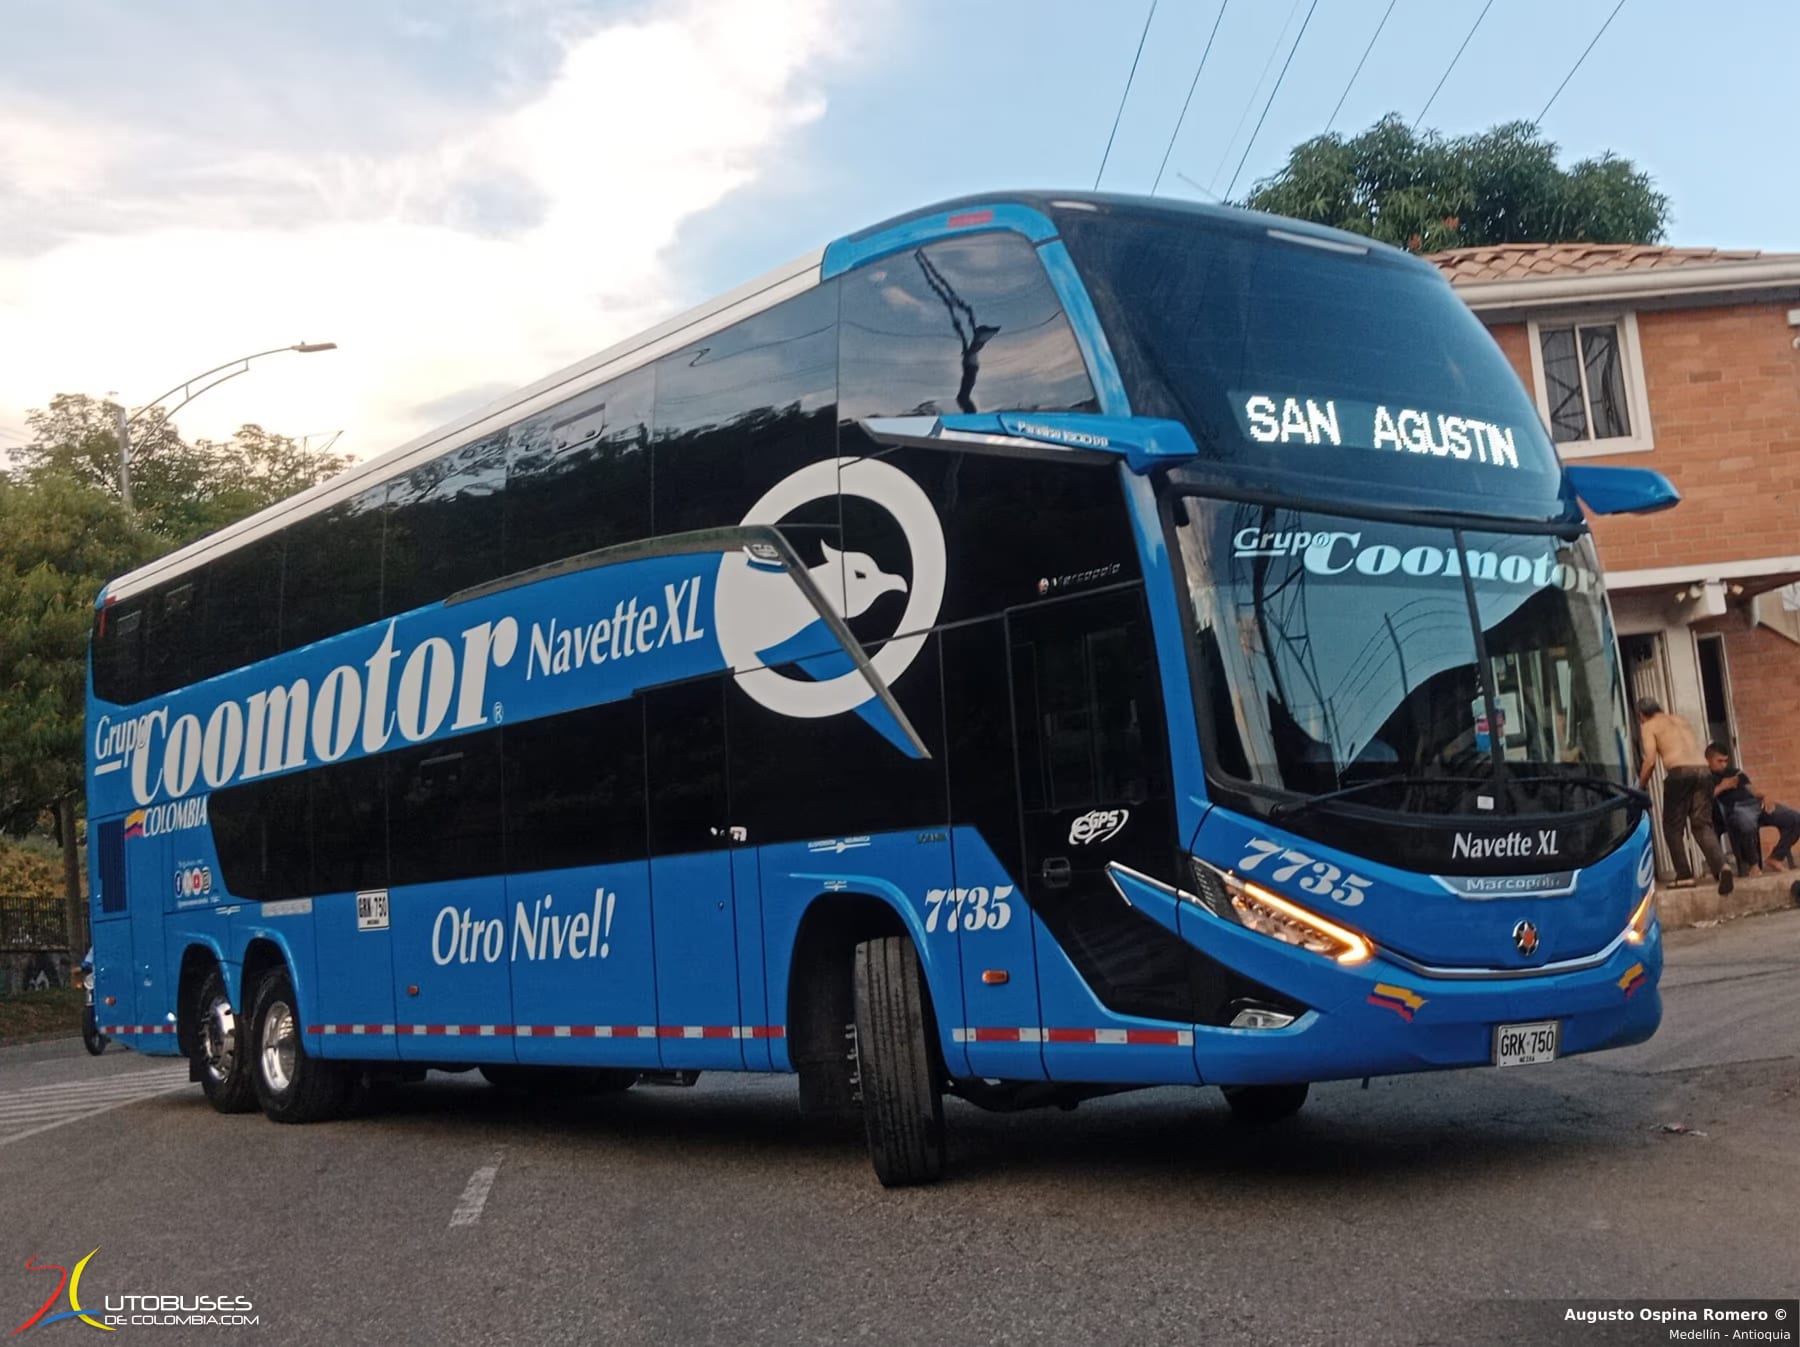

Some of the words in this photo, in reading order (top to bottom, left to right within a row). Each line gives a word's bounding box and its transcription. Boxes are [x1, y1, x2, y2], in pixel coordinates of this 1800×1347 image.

[1245, 395, 1341, 446] SAN
[1373, 405, 1519, 469] AGUSTIN
[1232, 527, 1331, 556] Grupo
[1303, 531, 1597, 593] Coomotor
[526, 595, 658, 681] Navette
[657, 575, 704, 648] XL
[95, 715, 149, 768] Grupo
[131, 616, 519, 806] Coomotor
[143, 795, 208, 838] COLOMBIA
[1452, 832, 1533, 859] Navette
[1536, 829, 1560, 856] XL
[1238, 837, 1374, 906] 7735
[432, 906, 504, 966] Otro
[511, 887, 616, 962] Nivel!
[925, 884, 1014, 933] 7735
[1501, 1032, 1527, 1056] GRK
[1531, 1030, 1555, 1053] 750
